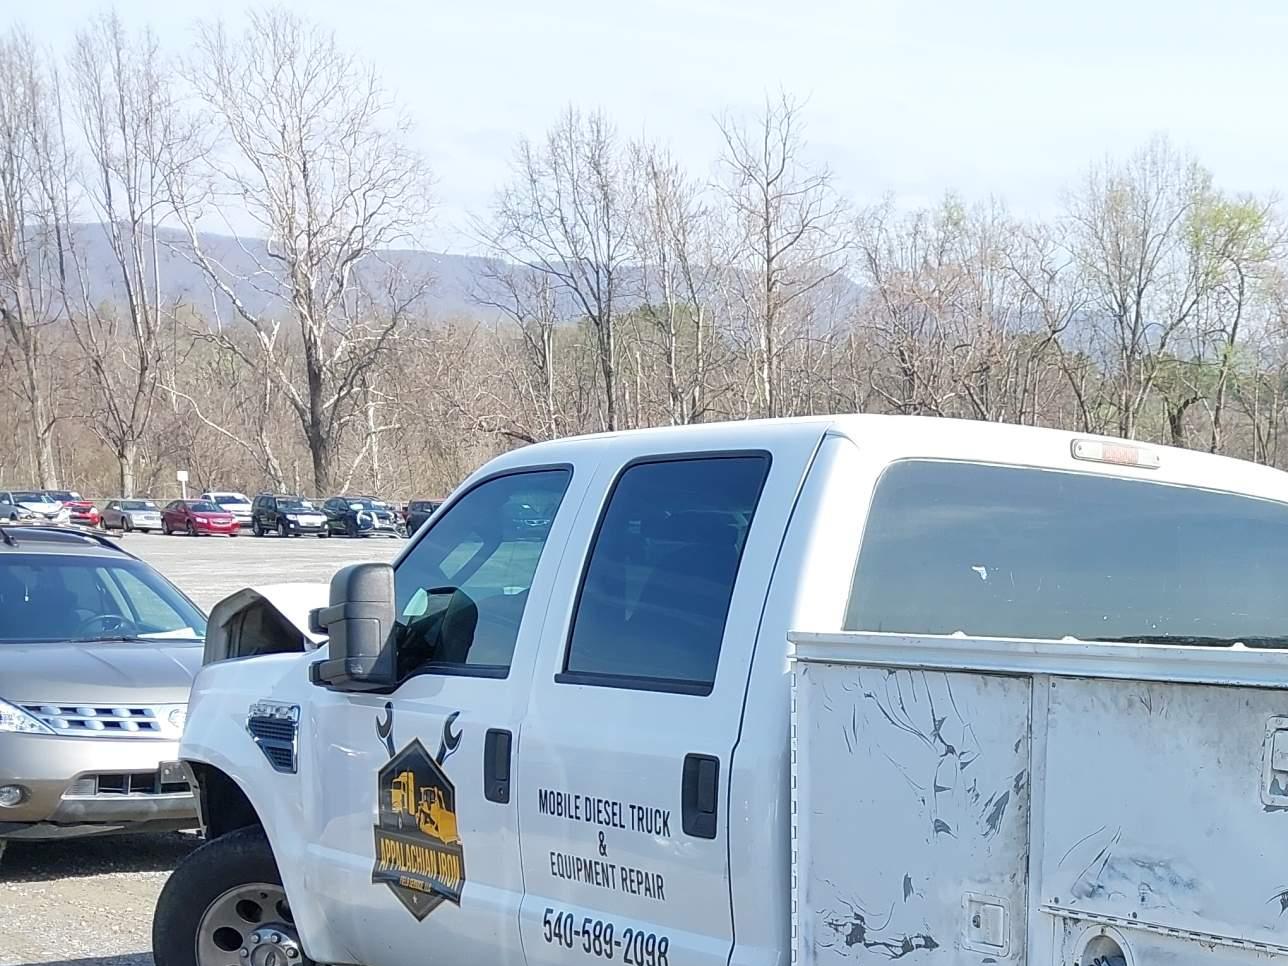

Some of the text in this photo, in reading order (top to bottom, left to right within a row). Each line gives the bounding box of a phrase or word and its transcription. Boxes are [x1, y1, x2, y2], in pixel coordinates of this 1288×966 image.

[538, 788, 671, 837] MOBILE DIESEL TRUCK
[379, 838, 460, 891] APPALACHIAN IRON
[598, 831, 608, 857] &
[550, 851, 666, 901] EQUIPMENT REPAIR
